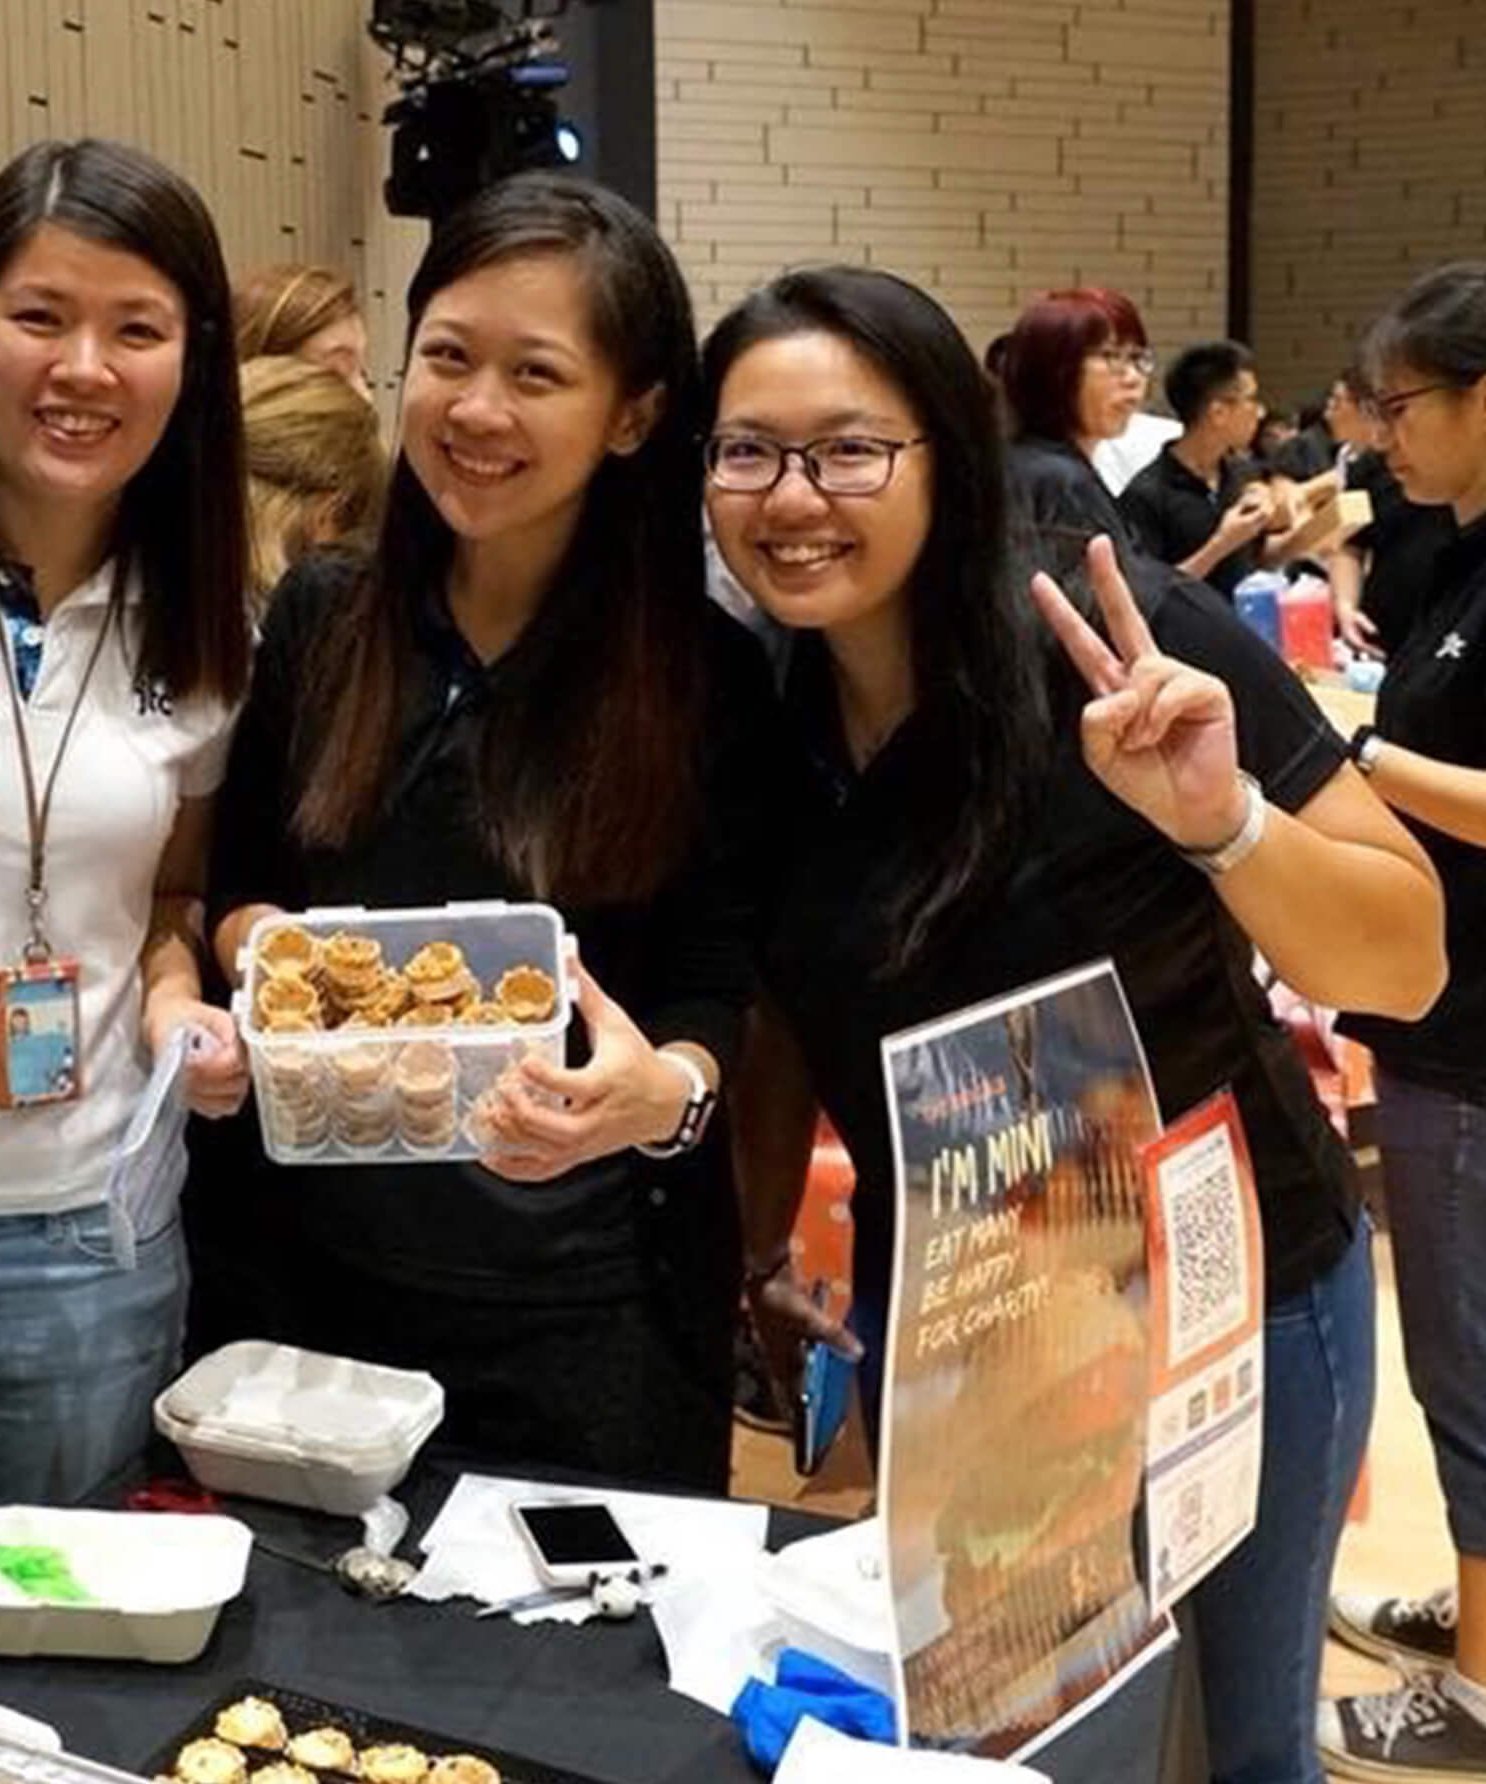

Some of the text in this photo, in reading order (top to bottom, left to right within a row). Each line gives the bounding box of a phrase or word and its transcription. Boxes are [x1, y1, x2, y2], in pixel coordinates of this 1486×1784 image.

[931, 1111, 1052, 1220] I'M MINI
[924, 1223, 966, 1271] EAT
[916, 1314, 961, 1358] FOR
